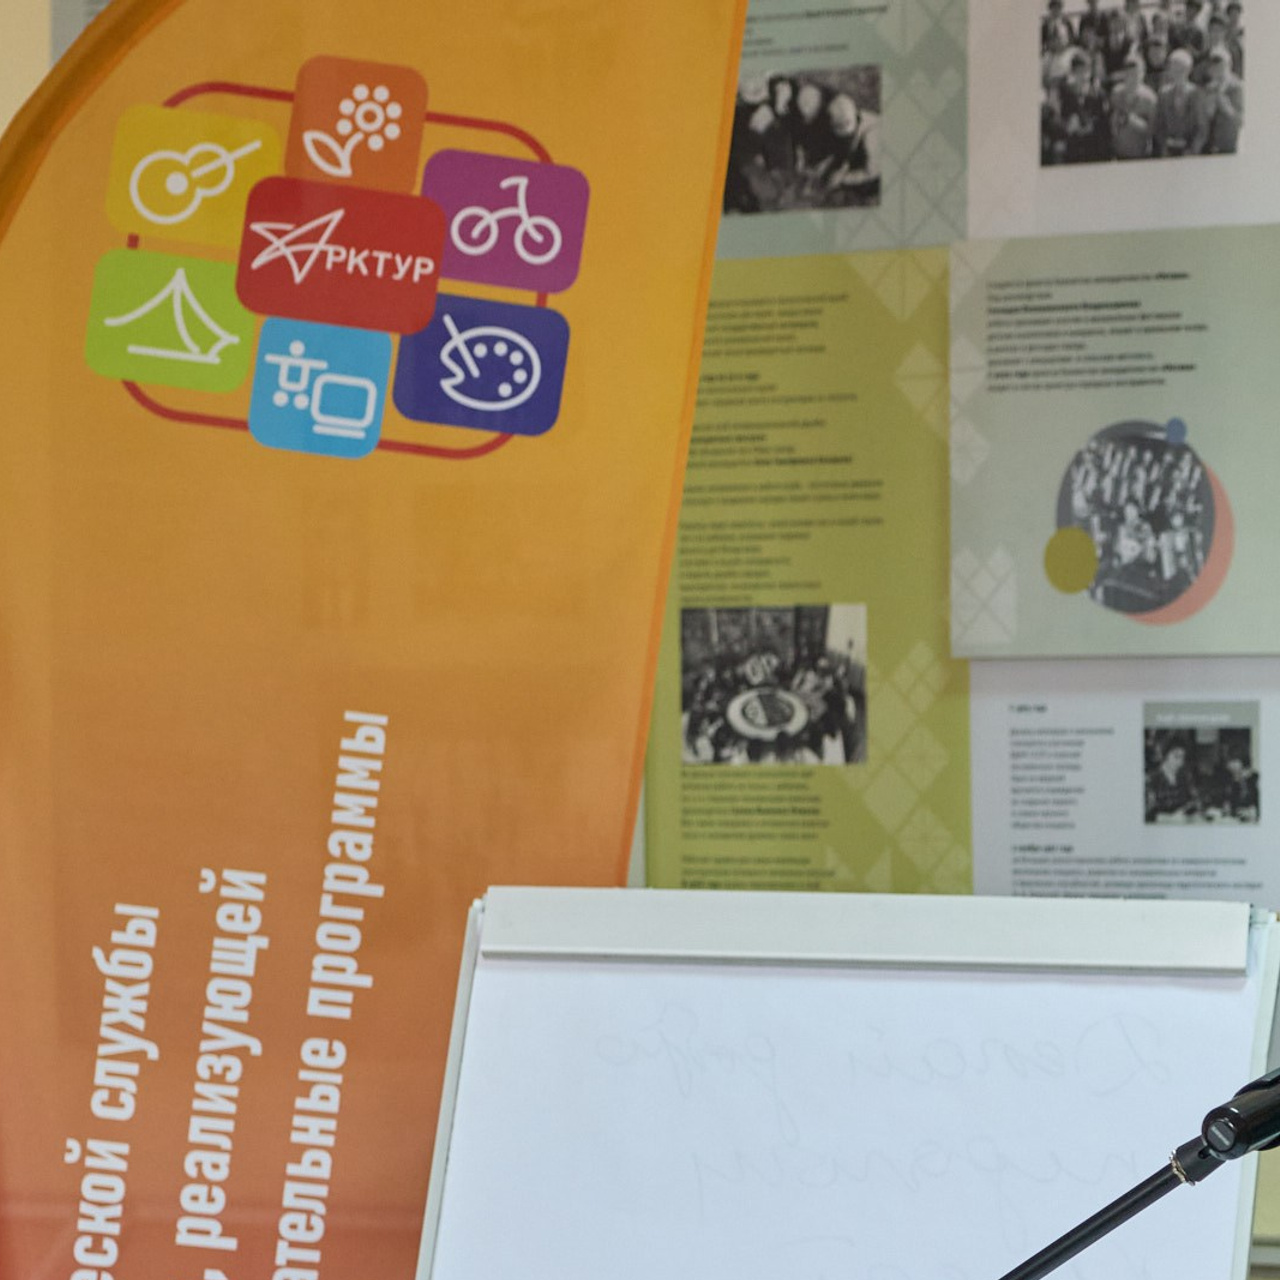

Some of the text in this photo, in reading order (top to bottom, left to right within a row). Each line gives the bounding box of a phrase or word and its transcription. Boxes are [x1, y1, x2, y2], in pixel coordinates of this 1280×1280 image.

[91, 903, 161, 1121] службы
[306, 710, 389, 1020] программы
[174, 867, 271, 1252] реализующей
